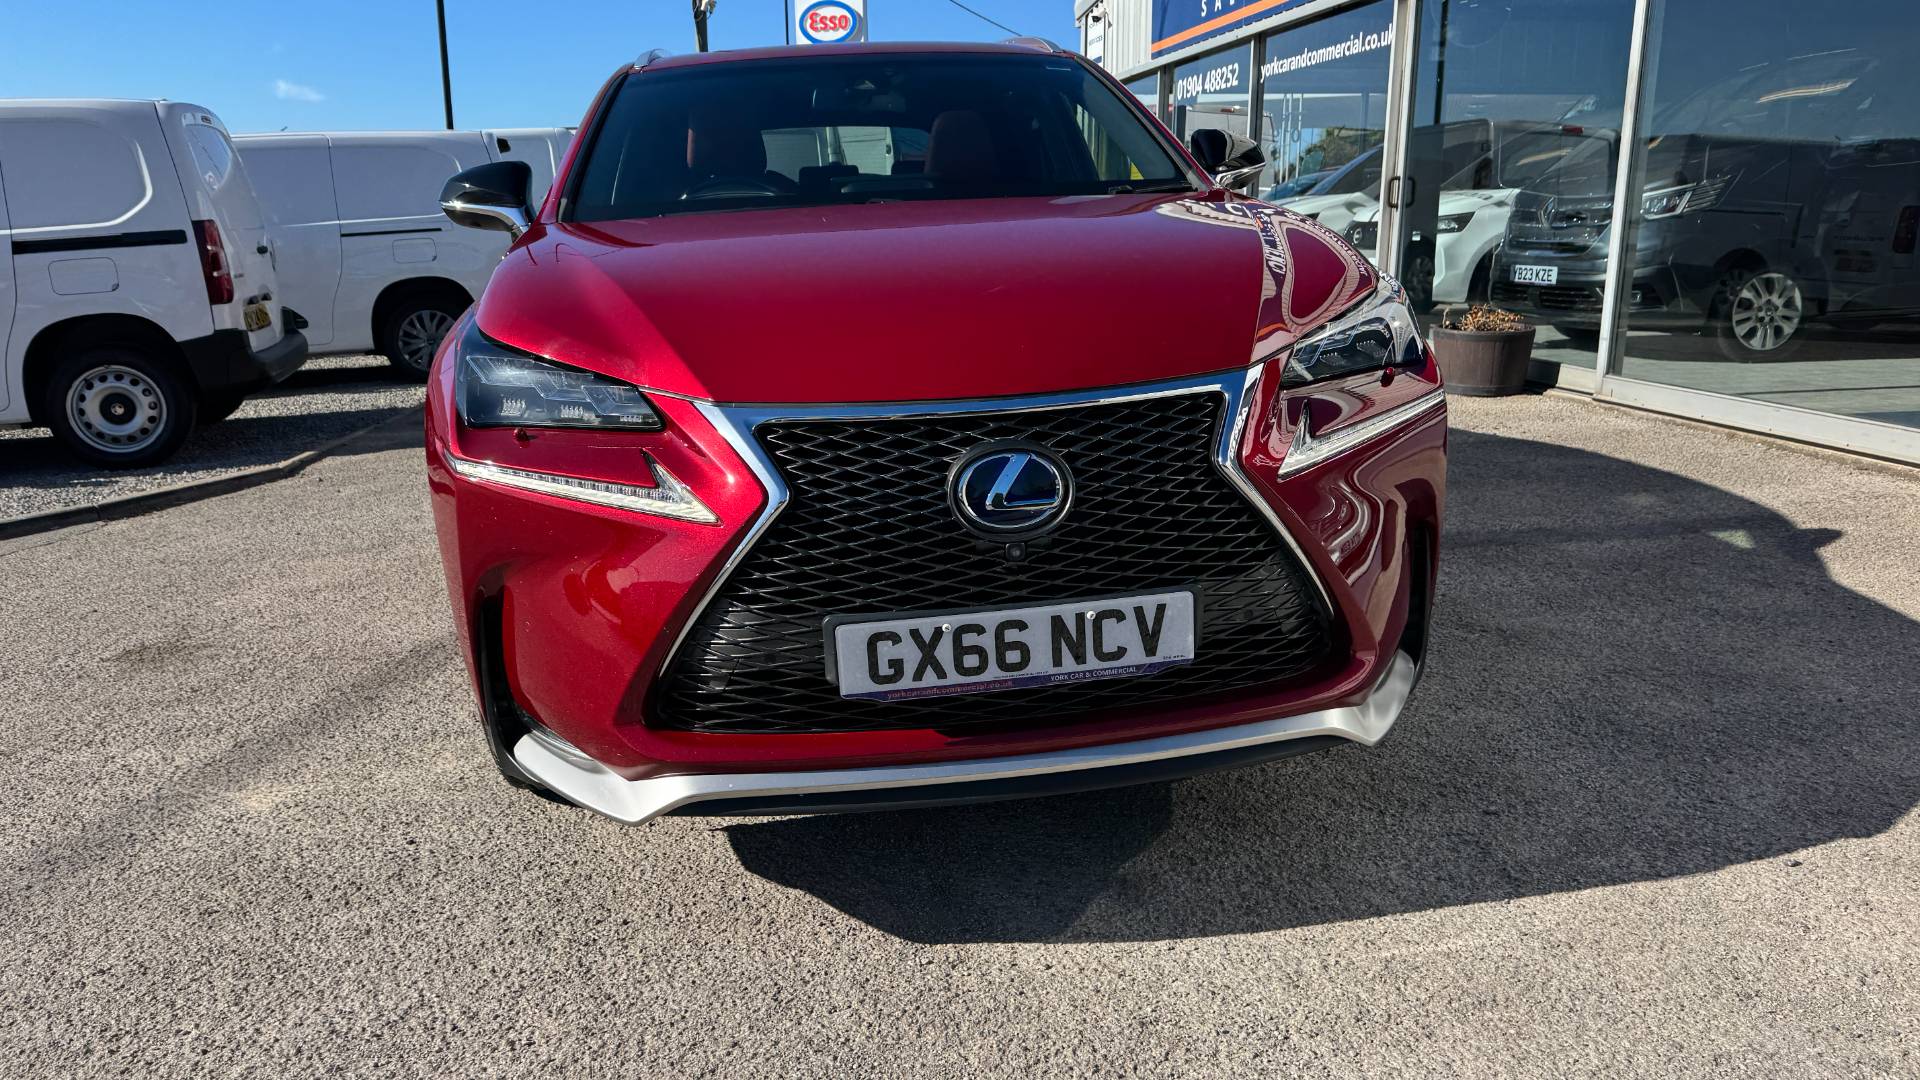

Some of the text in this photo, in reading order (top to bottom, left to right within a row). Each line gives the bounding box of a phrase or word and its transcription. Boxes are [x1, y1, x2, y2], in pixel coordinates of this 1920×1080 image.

[1177, 62, 1239, 100] 01904 488252
[1535, 268, 1553, 282] KZE
[866, 603, 1167, 685] GX66 NCV
[1092, 665, 1137, 677] COMMERCIAL
